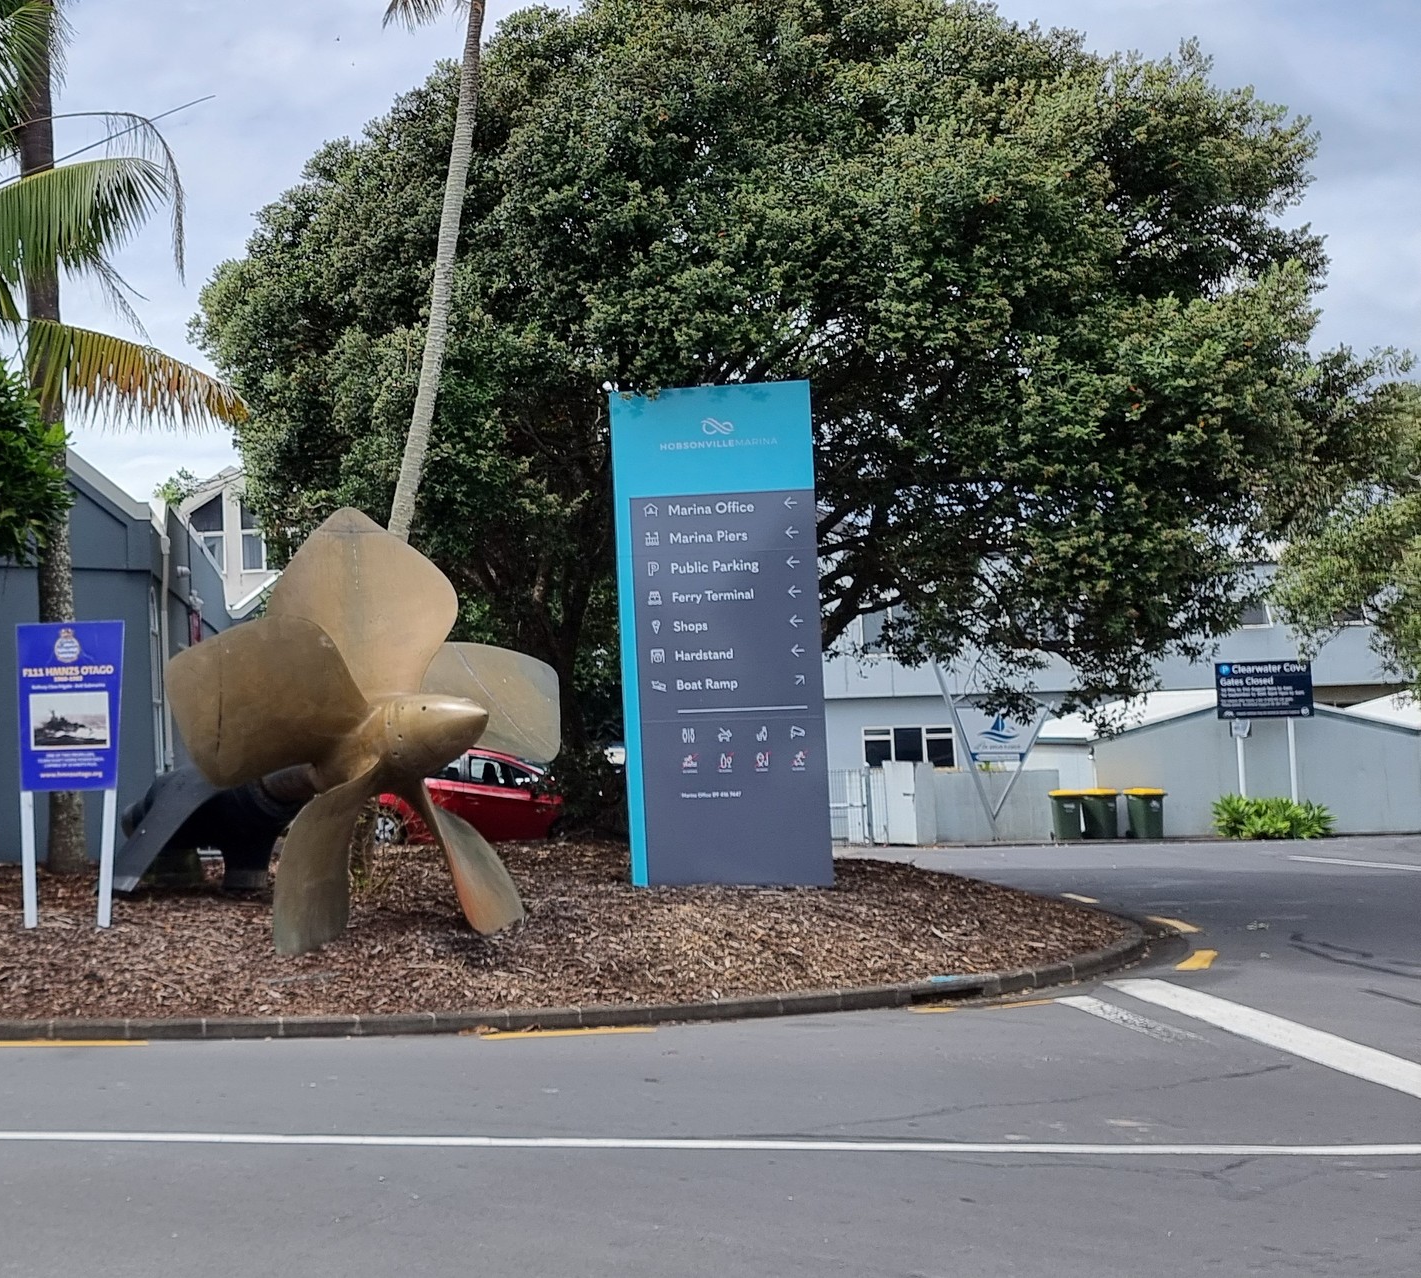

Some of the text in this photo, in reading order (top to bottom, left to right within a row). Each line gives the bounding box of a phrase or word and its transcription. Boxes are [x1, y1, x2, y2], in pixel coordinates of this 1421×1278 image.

[668, 501, 755, 517] Marina Office
[669, 530, 748, 544] Marina Piers
[671, 559, 759, 574] Public Parking
[672, 588, 754, 605] Ferry Terminal
[673, 621, 708, 633] Shops
[675, 648, 734, 661] Hardstand
[81, 665, 114, 675] OTAGO
[1232, 664, 1281, 674] Clearwater
[677, 678, 738, 692] Boat Ramp
[1220, 676, 1274, 686] Gates Closed
